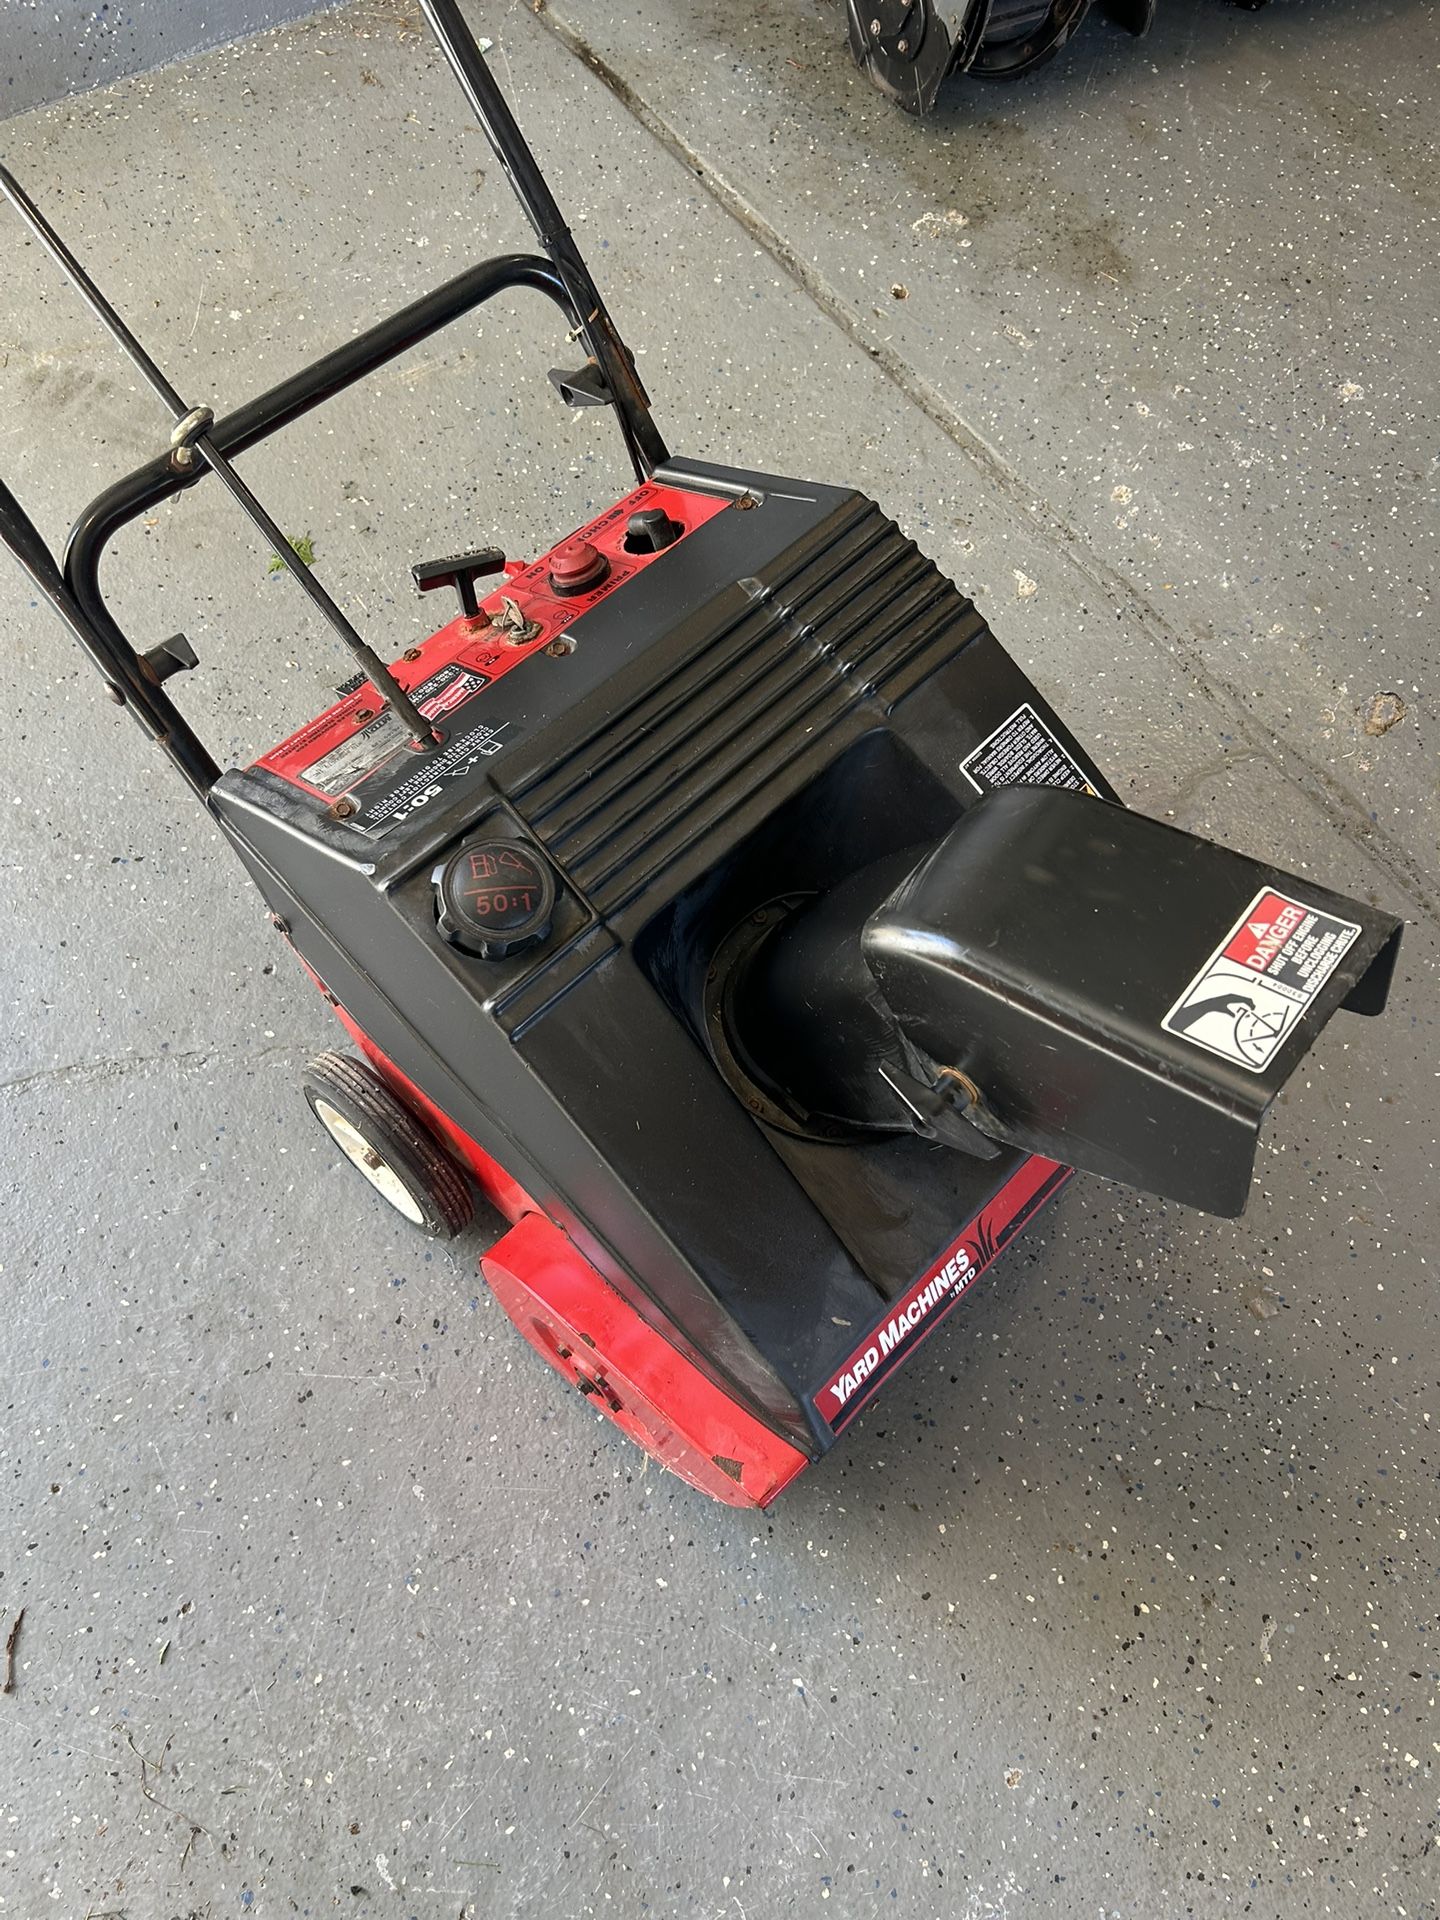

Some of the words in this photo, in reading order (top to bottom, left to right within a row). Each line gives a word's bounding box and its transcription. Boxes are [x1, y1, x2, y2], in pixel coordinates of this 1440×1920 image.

[627, 488, 650, 505] OFF
[576, 517, 610, 542] CHO
[525, 565, 544, 579] ON
[584, 568, 630, 603] PRIMER
[441, 724, 484, 756] CLOCKWISE
[470, 728, 494, 746] CRANK
[431, 756, 442, 764] TO
[445, 747, 469, 765] CHUTE
[1000, 763, 1008, 772] ALL
[1039, 748, 1054, 762] ALLOW
[386, 765, 430, 798] DISCHARGE
[407, 765, 446, 794] DIRECTION
[412, 758, 447, 784] DISCHARGE
[390, 783, 442, 822] 50:1
[396, 784, 413, 796] LEFT
[367, 796, 397, 818] COUNTER
[372, 795, 407, 821] CONTROL
[476, 893, 532, 915] 50:1
[1244, 904, 1303, 971] DANGER
[1266, 953, 1289, 975] SHUT
[1280, 939, 1299, 956] OFF
[1291, 912, 1319, 942] ENGINE
[1290, 933, 1319, 965] BEFORE
[1296, 930, 1337, 979] UNCLOGGING
[1301, 950, 1338, 993] DISCHARGE
[1327, 928, 1357, 965] CHUTE.
[954, 1267, 976, 1295] MTD
[829, 1346, 880, 1405] YARD
[878, 1248, 971, 1355] MACHINES
